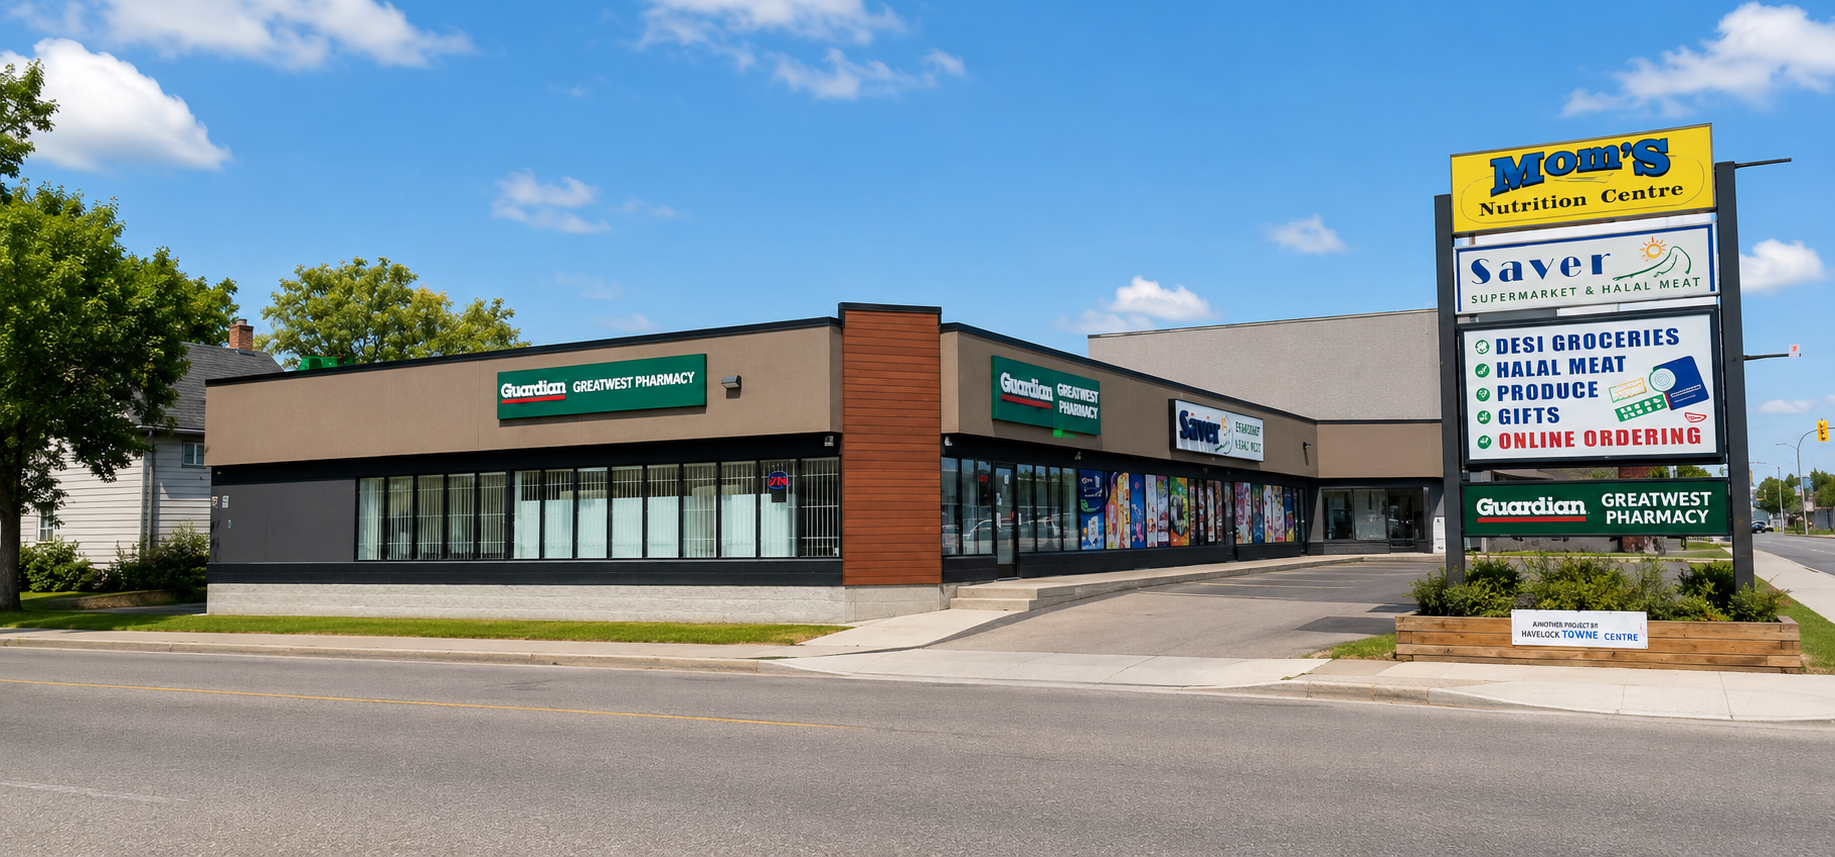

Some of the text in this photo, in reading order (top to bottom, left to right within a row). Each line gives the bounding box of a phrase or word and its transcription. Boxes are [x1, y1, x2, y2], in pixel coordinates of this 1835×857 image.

[1478, 184, 1684, 217] Nutrition Centre
[1471, 252, 1611, 284] Saver
[1471, 277, 1701, 304] SUPERMARKET & HALAL MEAT
[1496, 327, 1680, 355] DESI GROCERIES
[1496, 355, 1626, 378] HALAL MEAT
[500, 371, 695, 398] Guardian GREATWEST PHARMACY
[1000, 372, 1053, 402] Guardian
[1057, 383, 1099, 404] GREATWEST
[1497, 381, 1599, 402] PRODUCE
[1059, 400, 1098, 419] PHARMACY
[1498, 406, 1560, 425] GIFTS
[1179, 409, 1221, 445] Saver
[1499, 427, 1701, 449] ONLINE ORDERING
[1476, 497, 1587, 516] Guardian
[1601, 492, 1712, 507] GREATWEST
[1606, 509, 1709, 524] PHARMACY
[1521, 630, 1639, 641] HAVELOCK TOWNE CENTRE
